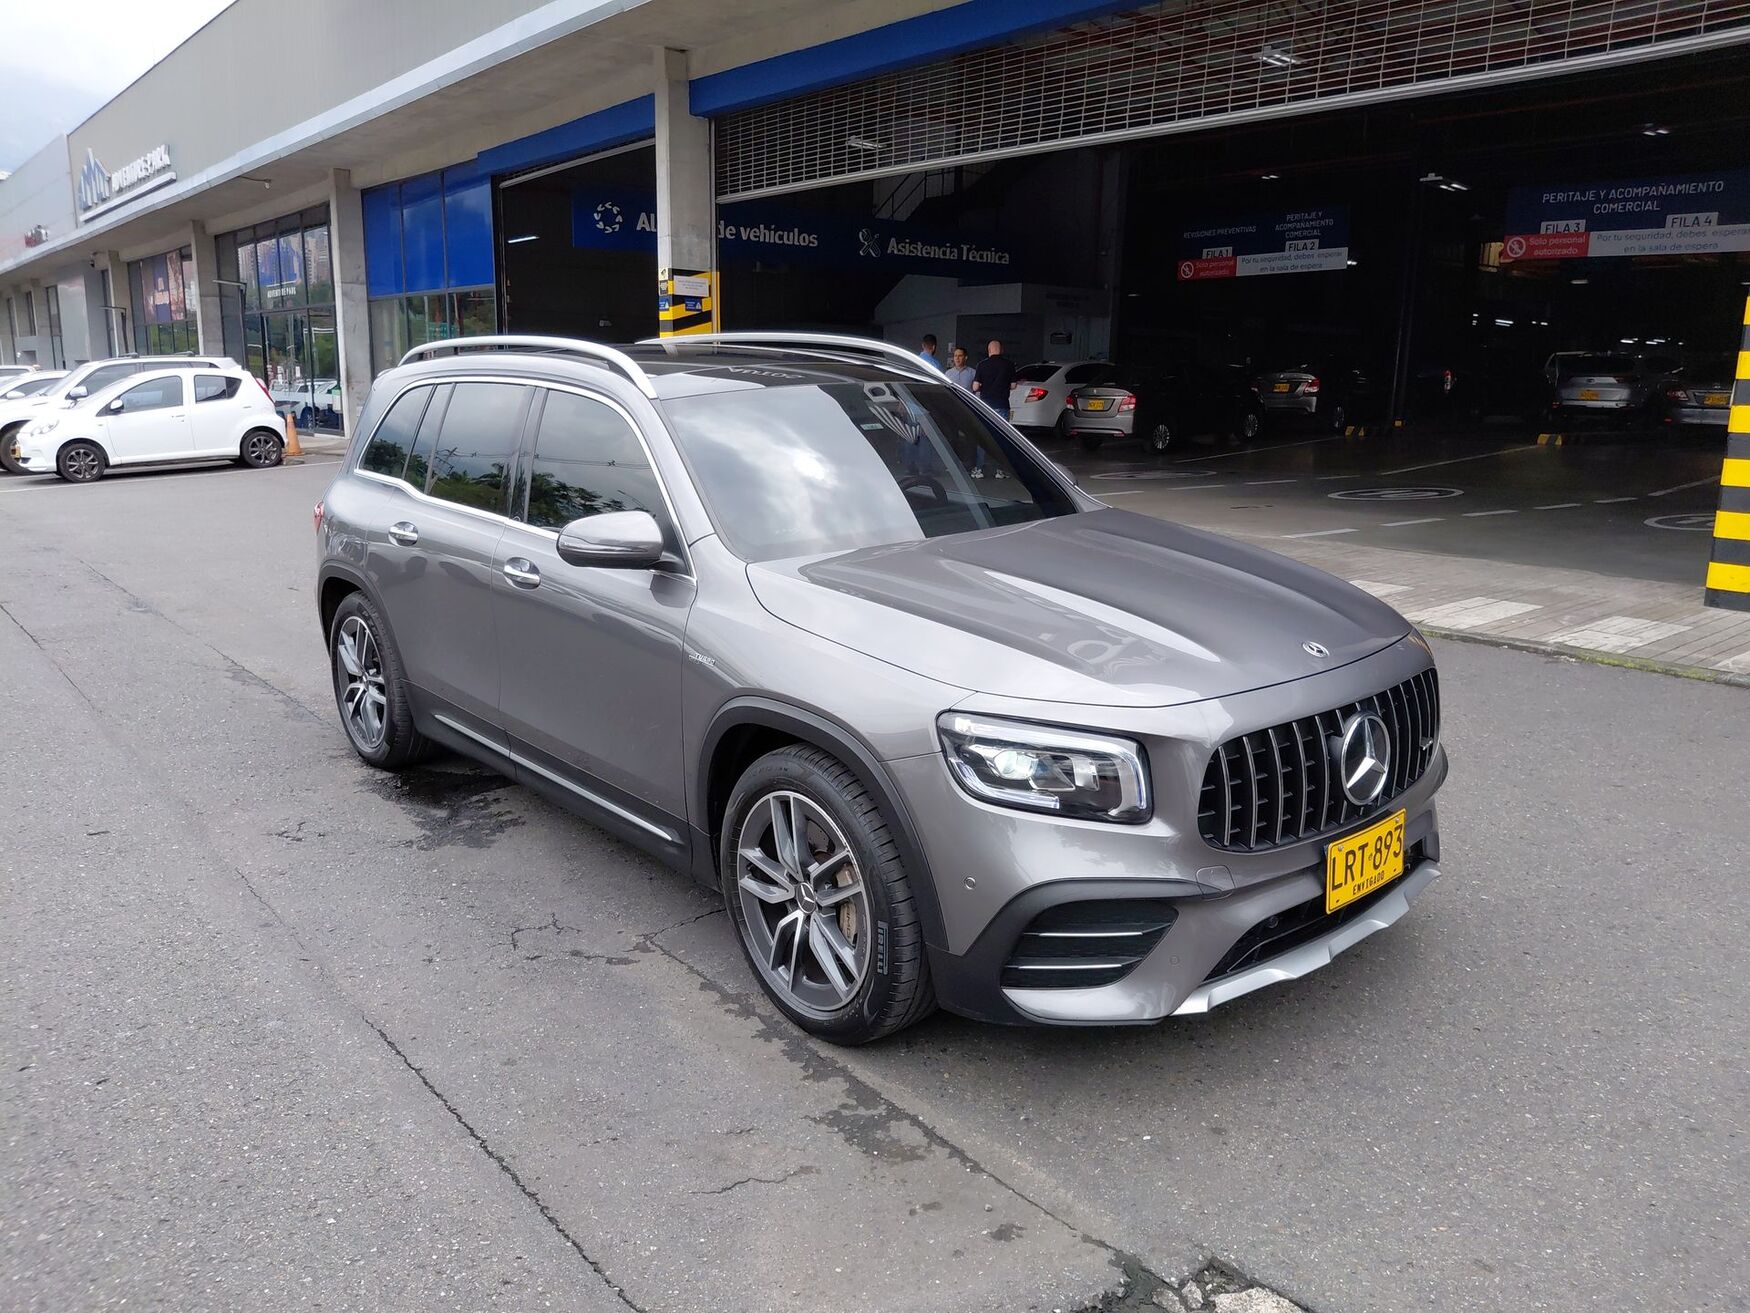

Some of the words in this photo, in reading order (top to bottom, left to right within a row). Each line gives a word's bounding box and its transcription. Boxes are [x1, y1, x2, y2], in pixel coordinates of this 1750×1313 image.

[1542, 190, 1596, 204] PERITAJE
[1599, 189, 1606, 200] Y
[1608, 180, 1724, 200] ACOMPAÑAMIENTO
[1593, 200, 1661, 214] COMERCIAL
[1286, 211, 1317, 222] PERITAJE
[1671, 215, 1700, 228] FILA
[1704, 216, 1712, 226] 4
[1217, 225, 1257, 236] PREVENTIVAS
[1285, 228, 1322, 239] COMERCIAL
[1545, 223, 1571, 234] FILA
[1574, 222, 1580, 232] 3
[739, 224, 819, 248] vehículos
[1676, 230, 1706, 239] debes
[1288, 242, 1308, 252] FILA
[1310, 241, 1315, 250] 2
[1549, 235, 1587, 247] personal
[887, 237, 958, 260] Asistencia
[960, 244, 1010, 265] Técnica
[1206, 249, 1223, 258] FILA
[1352, 870, 1385, 896] ENVIGADO
